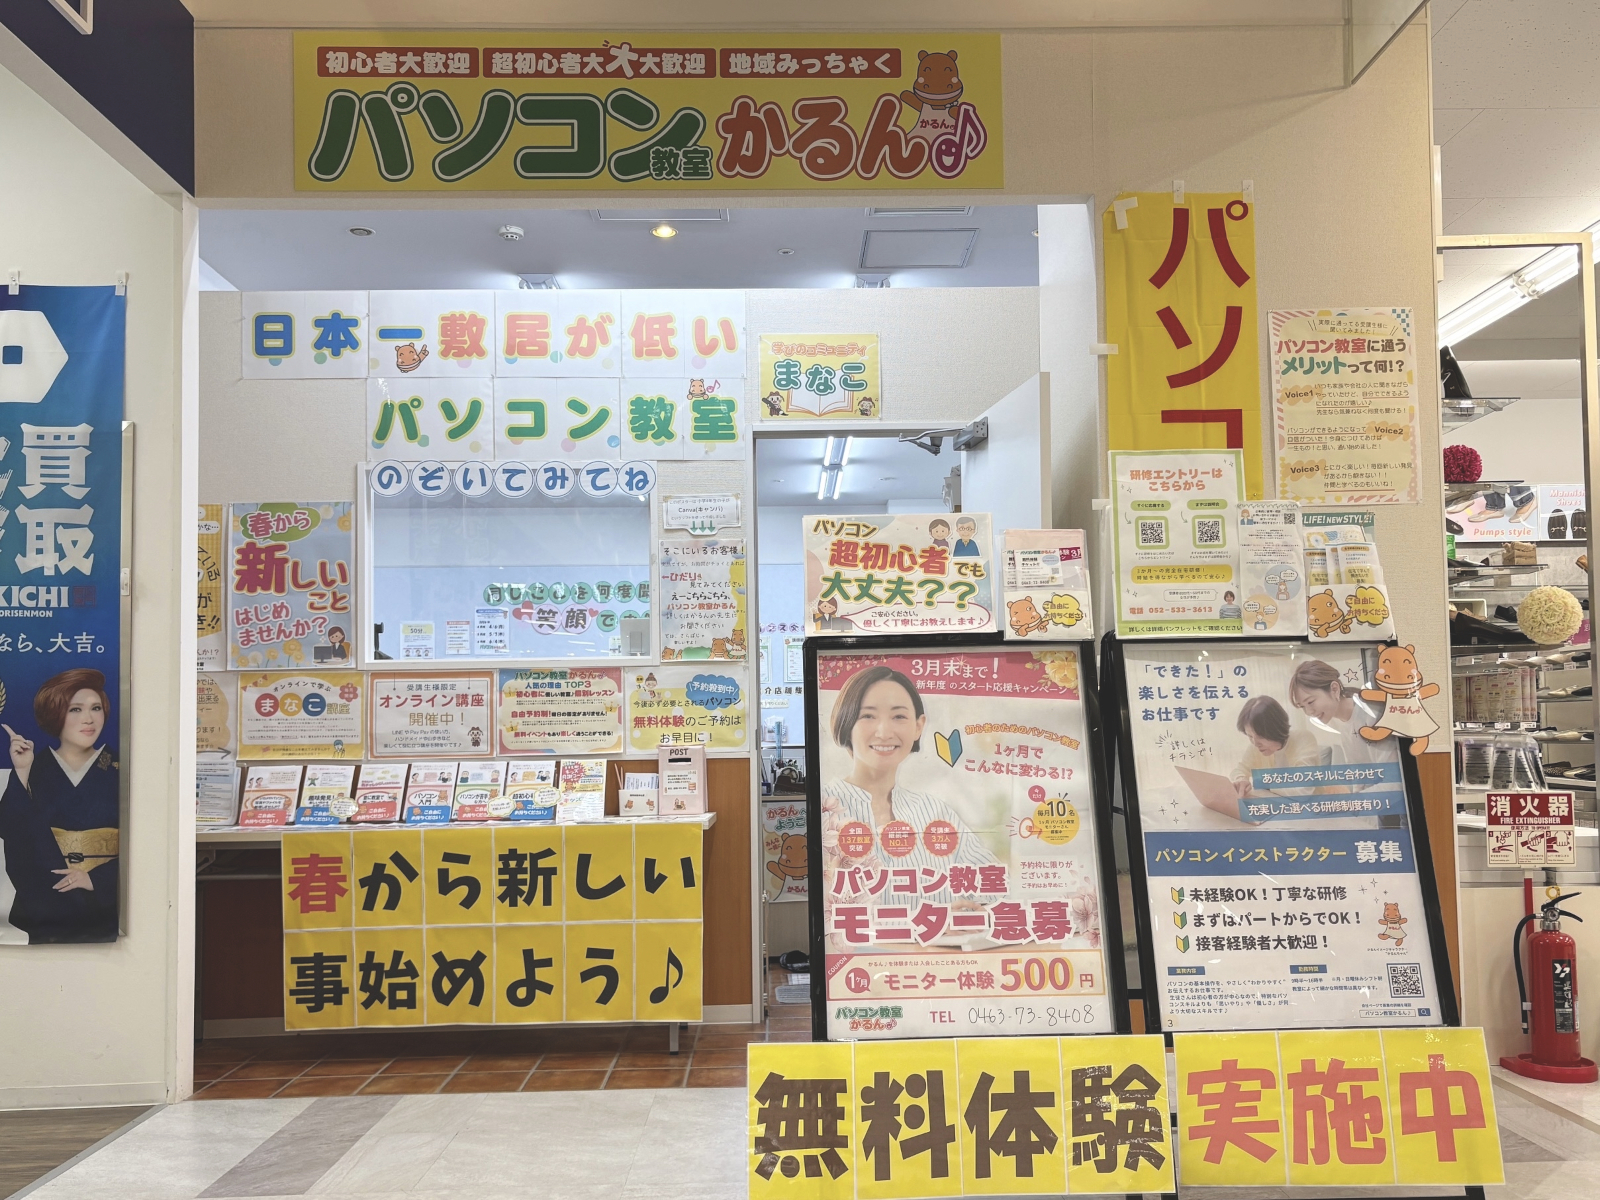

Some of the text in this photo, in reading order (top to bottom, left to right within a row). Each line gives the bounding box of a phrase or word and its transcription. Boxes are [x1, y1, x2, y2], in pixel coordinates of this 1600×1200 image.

[325, 50, 472, 76] 初心者大歓迎
[728, 51, 893, 76] 地域みっちゃく
[308, 81, 706, 183] パソコン
[649, 147, 713, 180] 教室
[252, 309, 739, 360] 日本一敷居が低い
[772, 342, 867, 357] 学びのコミュニティ
[1277, 338, 1406, 354] パソコン教室に通う
[773, 359, 868, 396] まなこ
[1285, 390, 1314, 399] Voice1
[373, 394, 739, 443] パソコン教室
[1374, 426, 1404, 435] Voice2
[1130, 468, 1223, 480] 研修エントリーは
[1290, 465, 1320, 474] Voice3
[376, 463, 651, 493] のぞいてみてね
[1149, 480, 1206, 492] こちらから
[14, 422, 95, 575] 買取
[1556, 498, 1581, 506] Shoes
[248, 511, 311, 538] 春から
[812, 518, 879, 539] パソコン
[1474, 527, 1532, 537] Pumps style
[664, 546, 744, 555] そこにいるお客様！
[828, 540, 950, 576] 超初心者
[234, 541, 348, 594] 新しい
[954, 561, 985, 578] でも
[820, 570, 977, 609] 大丈夫？？
[307, 589, 349, 611] こと
[234, 601, 290, 626] はじめ
[871, 610, 920, 618] ご安心ください。
[1129, 607, 1144, 615] 電話
[238, 616, 328, 646] ませんか？
[911, 657, 999, 680] 3月末まで！
[273, 680, 331, 693] オンラインで学ぶ
[564, 680, 592, 688] TOP3
[692, 681, 735, 694] 予約殺到中
[916, 680, 1068, 695] 新年度のスタート応援キャンペーン
[1138, 684, 1250, 699] 楽しさを伝える
[259, 698, 322, 713] まなこ
[379, 693, 484, 708] オンライン講座
[633, 697, 741, 708] 今後必ず必要とされるパソコン
[326, 703, 350, 715] 講座
[1142, 707, 1220, 722] お仕事です
[409, 712, 464, 726] 開催中！
[633, 715, 741, 728] 無料体験のご予約は
[660, 732, 713, 743] お早目に！
[965, 723, 1081, 750] 初心者のためのパソコン教室
[1171, 737, 1206, 750] 詳しくは
[669, 748, 688, 756] POST
[1261, 768, 1385, 784] あなたのスキルに合わせて
[1247, 800, 1392, 816] 充実した選べる研修制度有り！
[1491, 795, 1569, 816] 消火器
[842, 836, 871, 844] 137教室
[889, 839, 908, 847] NO.1
[1155, 840, 1403, 863] パソコンインストラクター 募集
[1020, 860, 1073, 870] 予約枠に限りが
[287, 847, 697, 914] 春から新しい
[832, 864, 1008, 895] パソコン教室
[1020, 871, 1062, 880] ございます。
[1189, 885, 1348, 903] 未経験OK！丁寧な研修
[833, 900, 1074, 944] モニター急募
[1192, 911, 1362, 928] まずはパートからでOK！
[1195, 933, 1329, 951] 接客経験者大歓迎！
[827, 955, 848, 976] COUPON
[884, 957, 1094, 992] モニター体験 500 円
[835, 1006, 903, 1019] パソコン教室
[929, 1010, 956, 1024] TEL
[968, 1004, 1095, 1026] 0463-73-8408
[849, 1019, 884, 1031] かるん
[754, 1053, 1487, 1182] 無料体験 実施中
